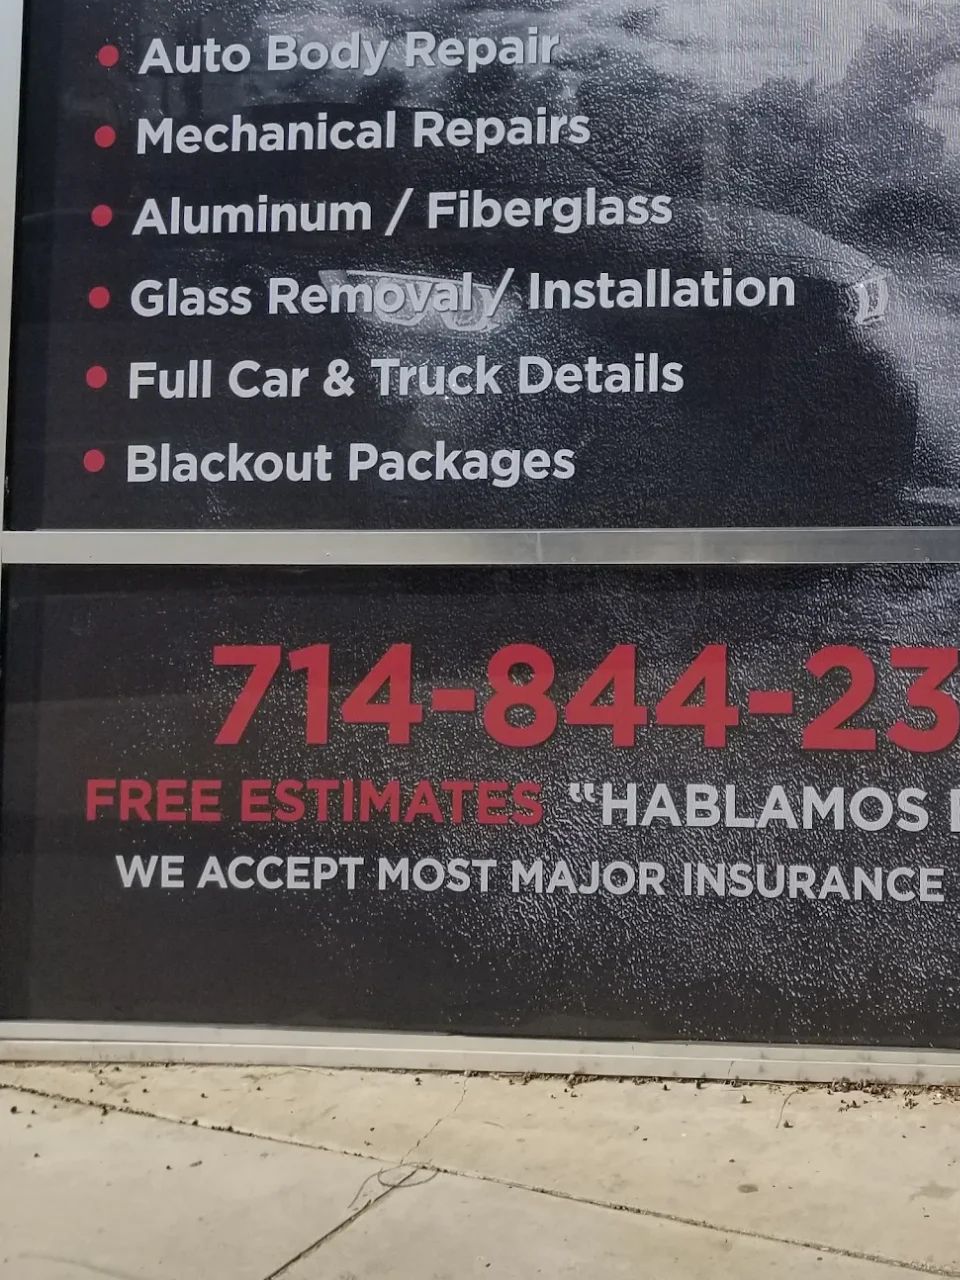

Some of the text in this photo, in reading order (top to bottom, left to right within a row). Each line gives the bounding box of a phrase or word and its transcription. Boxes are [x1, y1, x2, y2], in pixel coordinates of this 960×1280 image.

[139, 27, 560, 77] Auto Body Repair
[136, 107, 591, 155] Mechanical Repairs
[132, 196, 371, 235] Aluminum
[427, 187, 672, 233] Fiberglass
[131, 277, 251, 316] Glass
[268, 272, 473, 315] Removal
[530, 267, 795, 310] Installation
[129, 352, 684, 400] Full Car & Truck Details
[127, 441, 576, 487] Blackout Packages
[86, 779, 222, 821] FREE
[240, 779, 543, 825] ESTIMATES
[116, 855, 184, 888] WE
[197, 855, 364, 889] ACCEPT
[379, 858, 496, 892] MOST
[512, 860, 665, 896] MAJOR
[683, 862, 944, 903] INSURANCE
